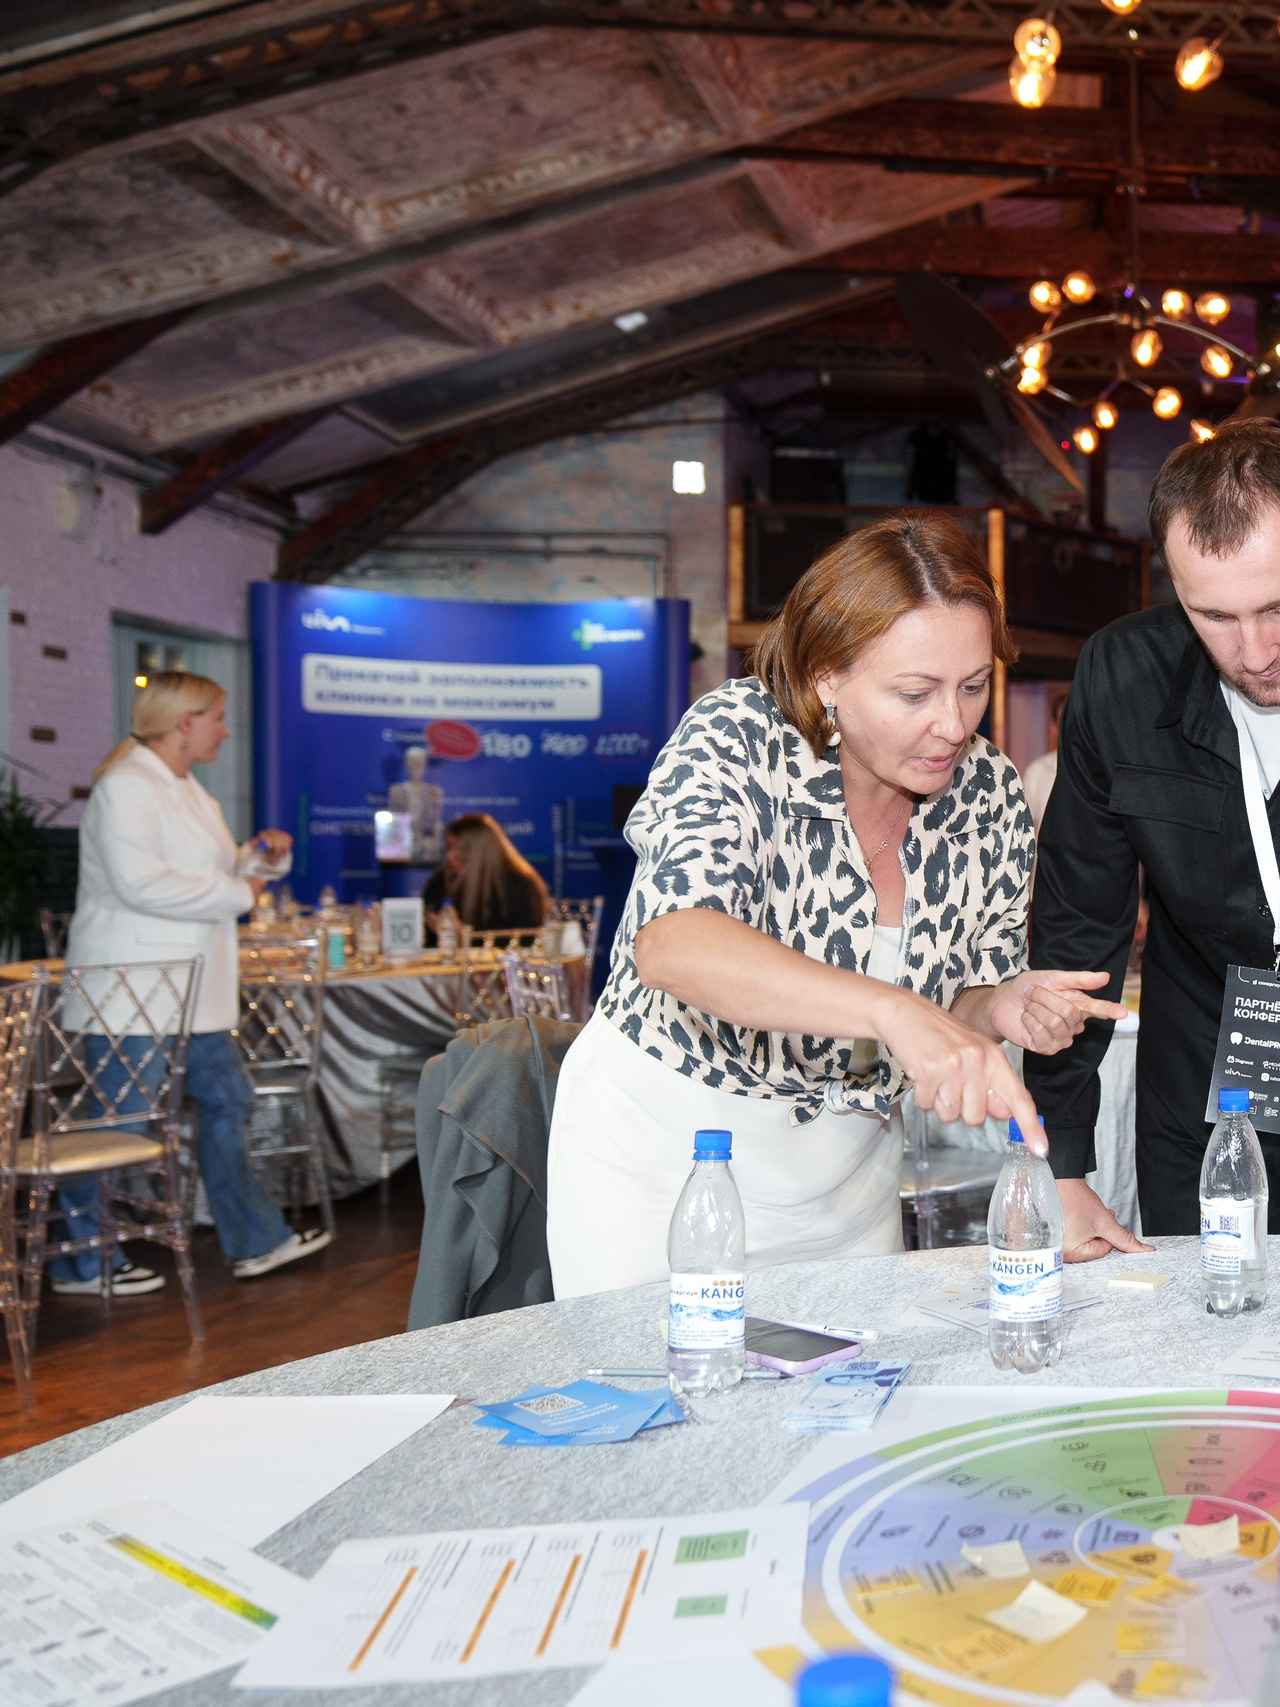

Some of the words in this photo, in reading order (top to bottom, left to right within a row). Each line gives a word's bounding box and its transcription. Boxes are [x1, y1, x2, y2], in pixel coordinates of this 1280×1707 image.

[315, 662, 421, 684] Прокачай
[427, 672, 589, 689] заполняемость
[315, 690, 404, 706] клиники
[410, 696, 437, 708] на
[443, 697, 556, 715] максимум
[992, 1260, 1044, 1275] KANGEN
[701, 1287, 744, 1299] KANG
